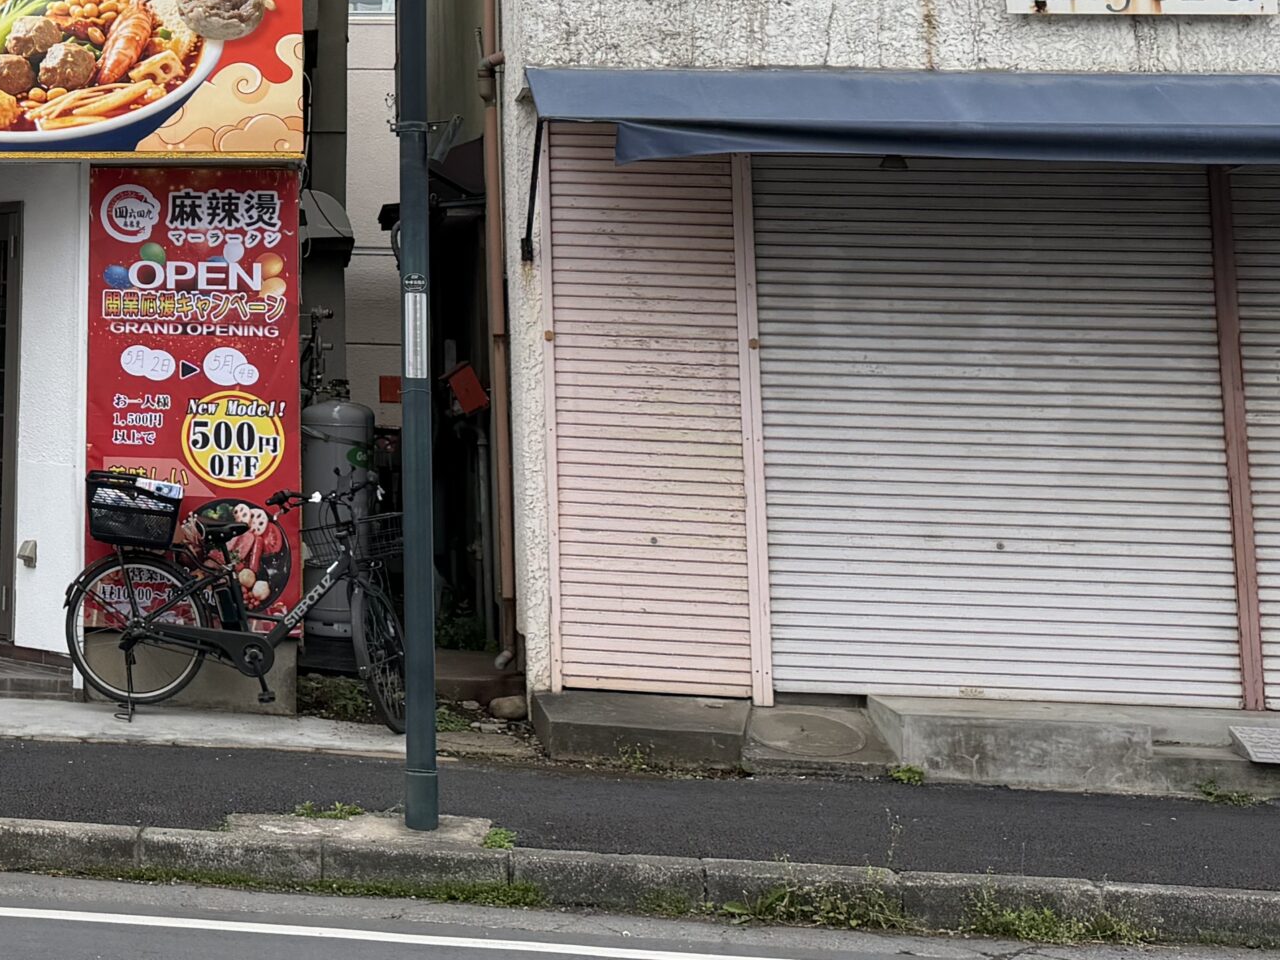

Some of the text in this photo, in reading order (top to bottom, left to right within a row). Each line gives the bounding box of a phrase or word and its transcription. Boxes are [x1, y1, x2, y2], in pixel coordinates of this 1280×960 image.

[168, 191, 279, 229] 麻辣燙
[169, 232, 280, 246] マーラータン
[128, 261, 262, 291] OPEN
[104, 291, 286, 322] 開業応援キャンペーン
[110, 322, 279, 338] GRAND OPENING
[114, 395, 170, 408] お一人様
[187, 399, 286, 418] New Model!
[113, 431, 155, 444] 以上で
[191, 421, 278, 453] 500円
[210, 454, 259, 477] OFF
